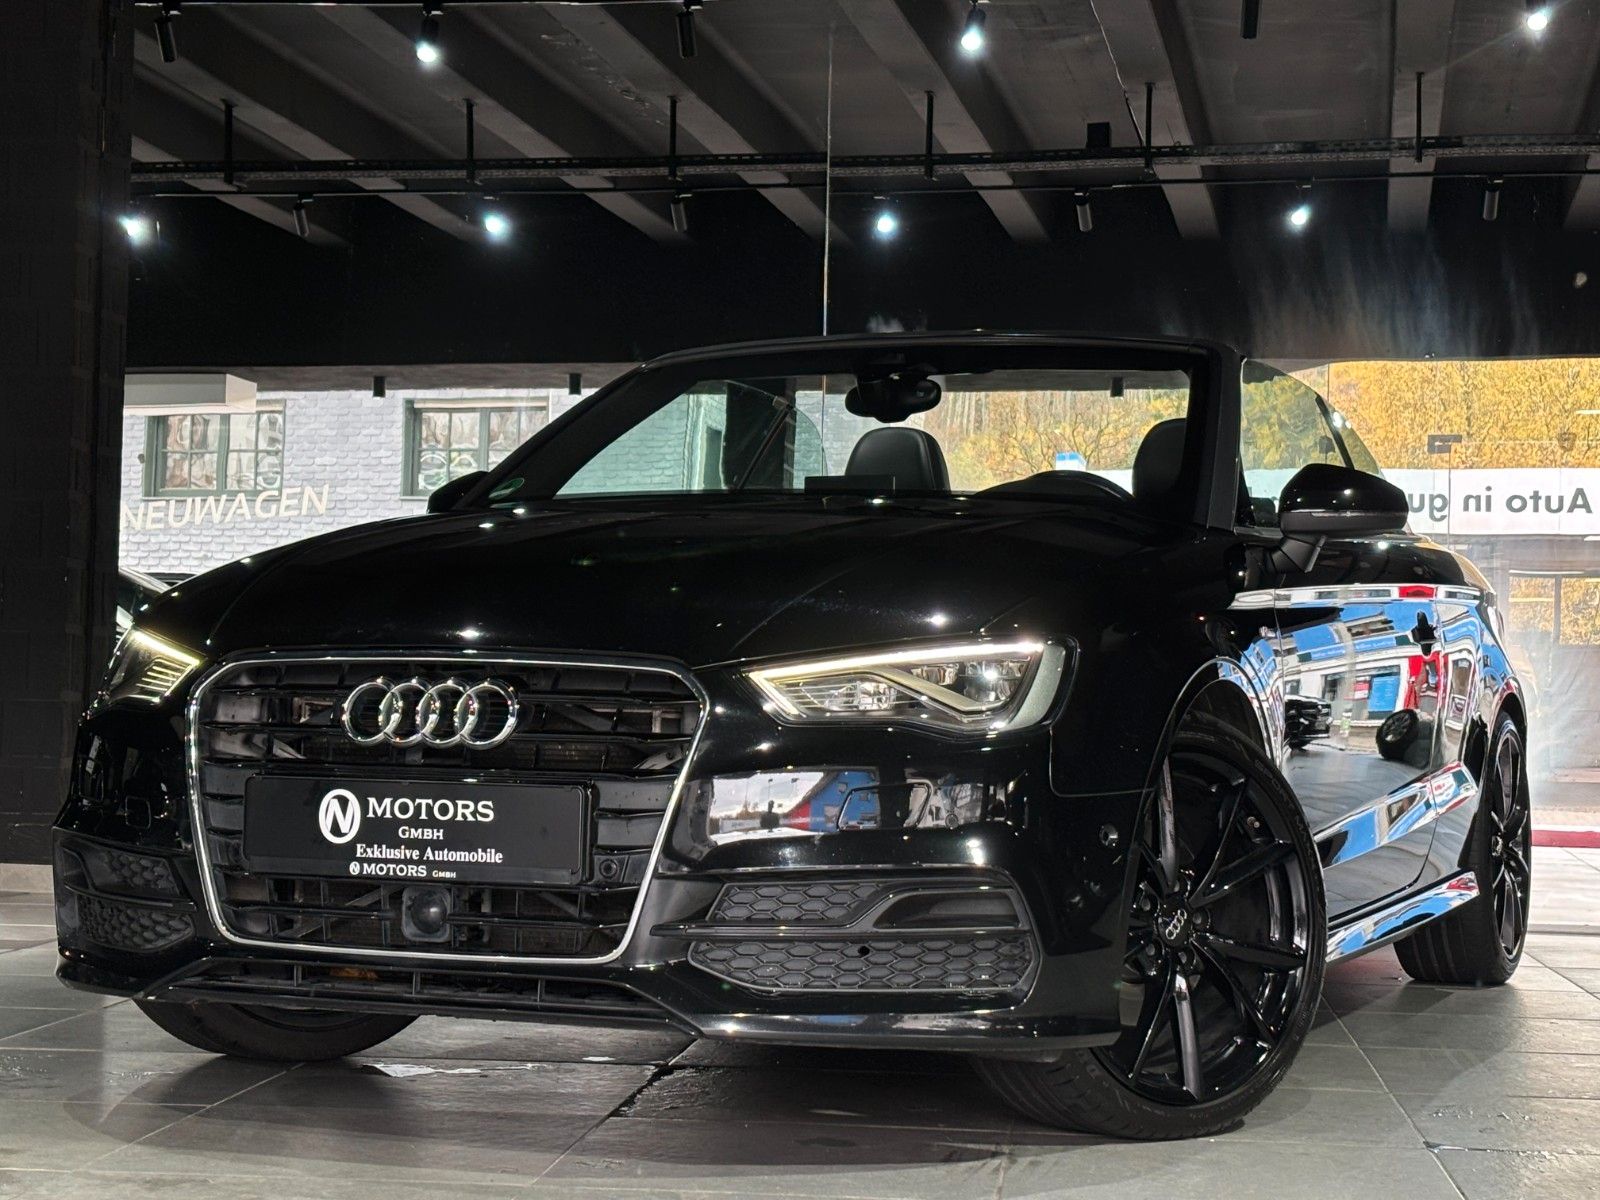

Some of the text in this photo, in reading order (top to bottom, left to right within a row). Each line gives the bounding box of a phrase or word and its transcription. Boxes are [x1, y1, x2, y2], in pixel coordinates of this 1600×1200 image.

[120, 483, 330, 531] NEUWAGEN
[366, 797, 494, 822] MOTORS
[398, 825, 444, 840] GMBH
[355, 843, 504, 864] Exklusive Automobile
[362, 863, 427, 877] MOTORS
[432, 869, 457, 879] GMBH
